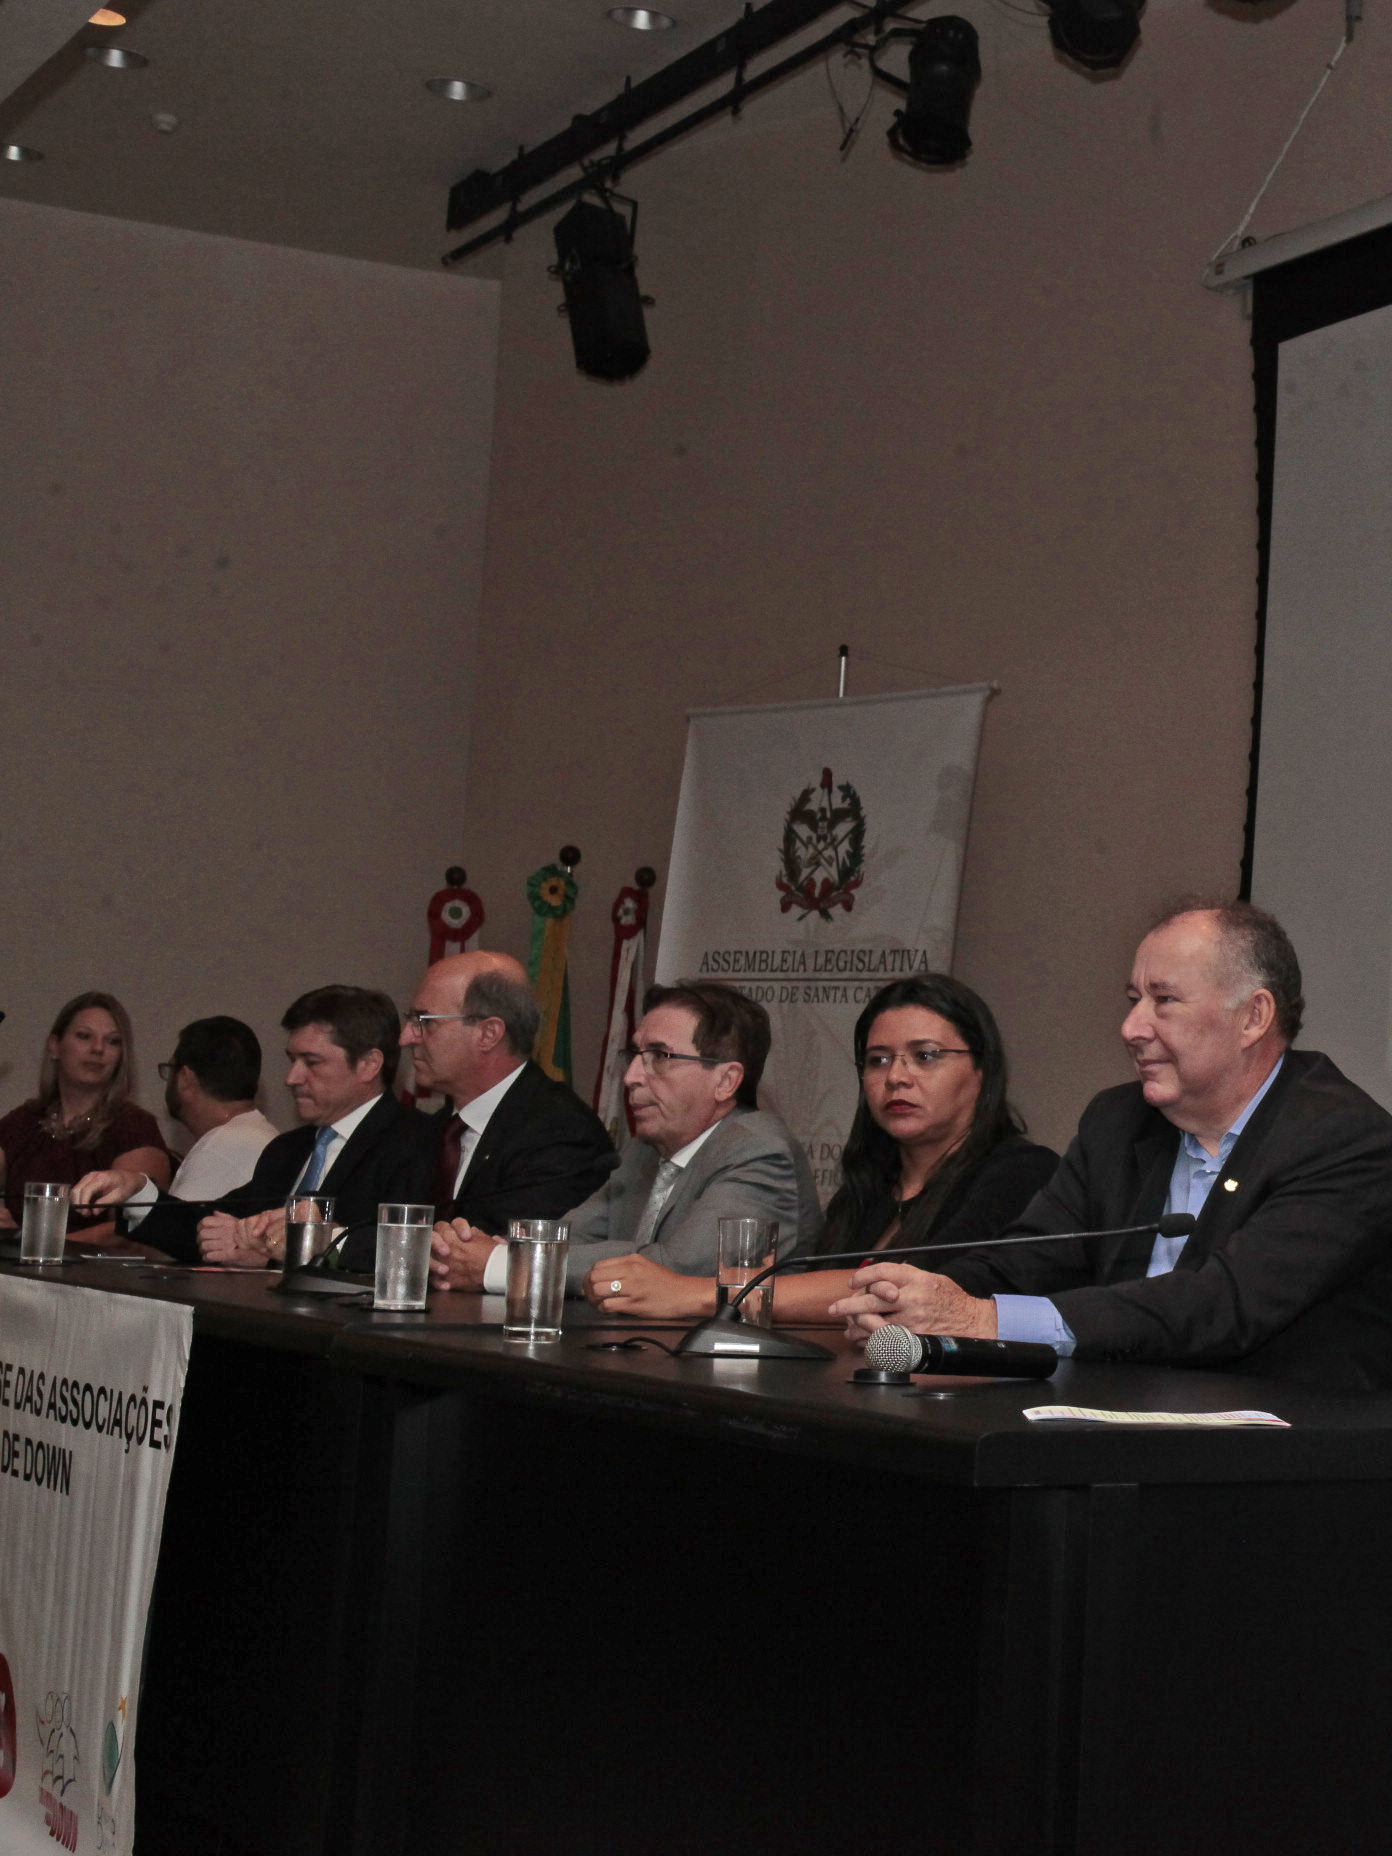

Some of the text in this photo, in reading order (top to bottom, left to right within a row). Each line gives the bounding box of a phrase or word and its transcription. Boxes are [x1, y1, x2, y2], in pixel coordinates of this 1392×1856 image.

[699, 948, 929, 974] ASSEMBLEIA LEGISLATIVA
[779, 985, 799, 1004] DE
[802, 984, 848, 1005] SANTA
[14, 1366, 46, 1417] DAS
[45, 1375, 174, 1453] ASSOCIAÇÕES
[1, 1430, 74, 1497] DE DOWN
